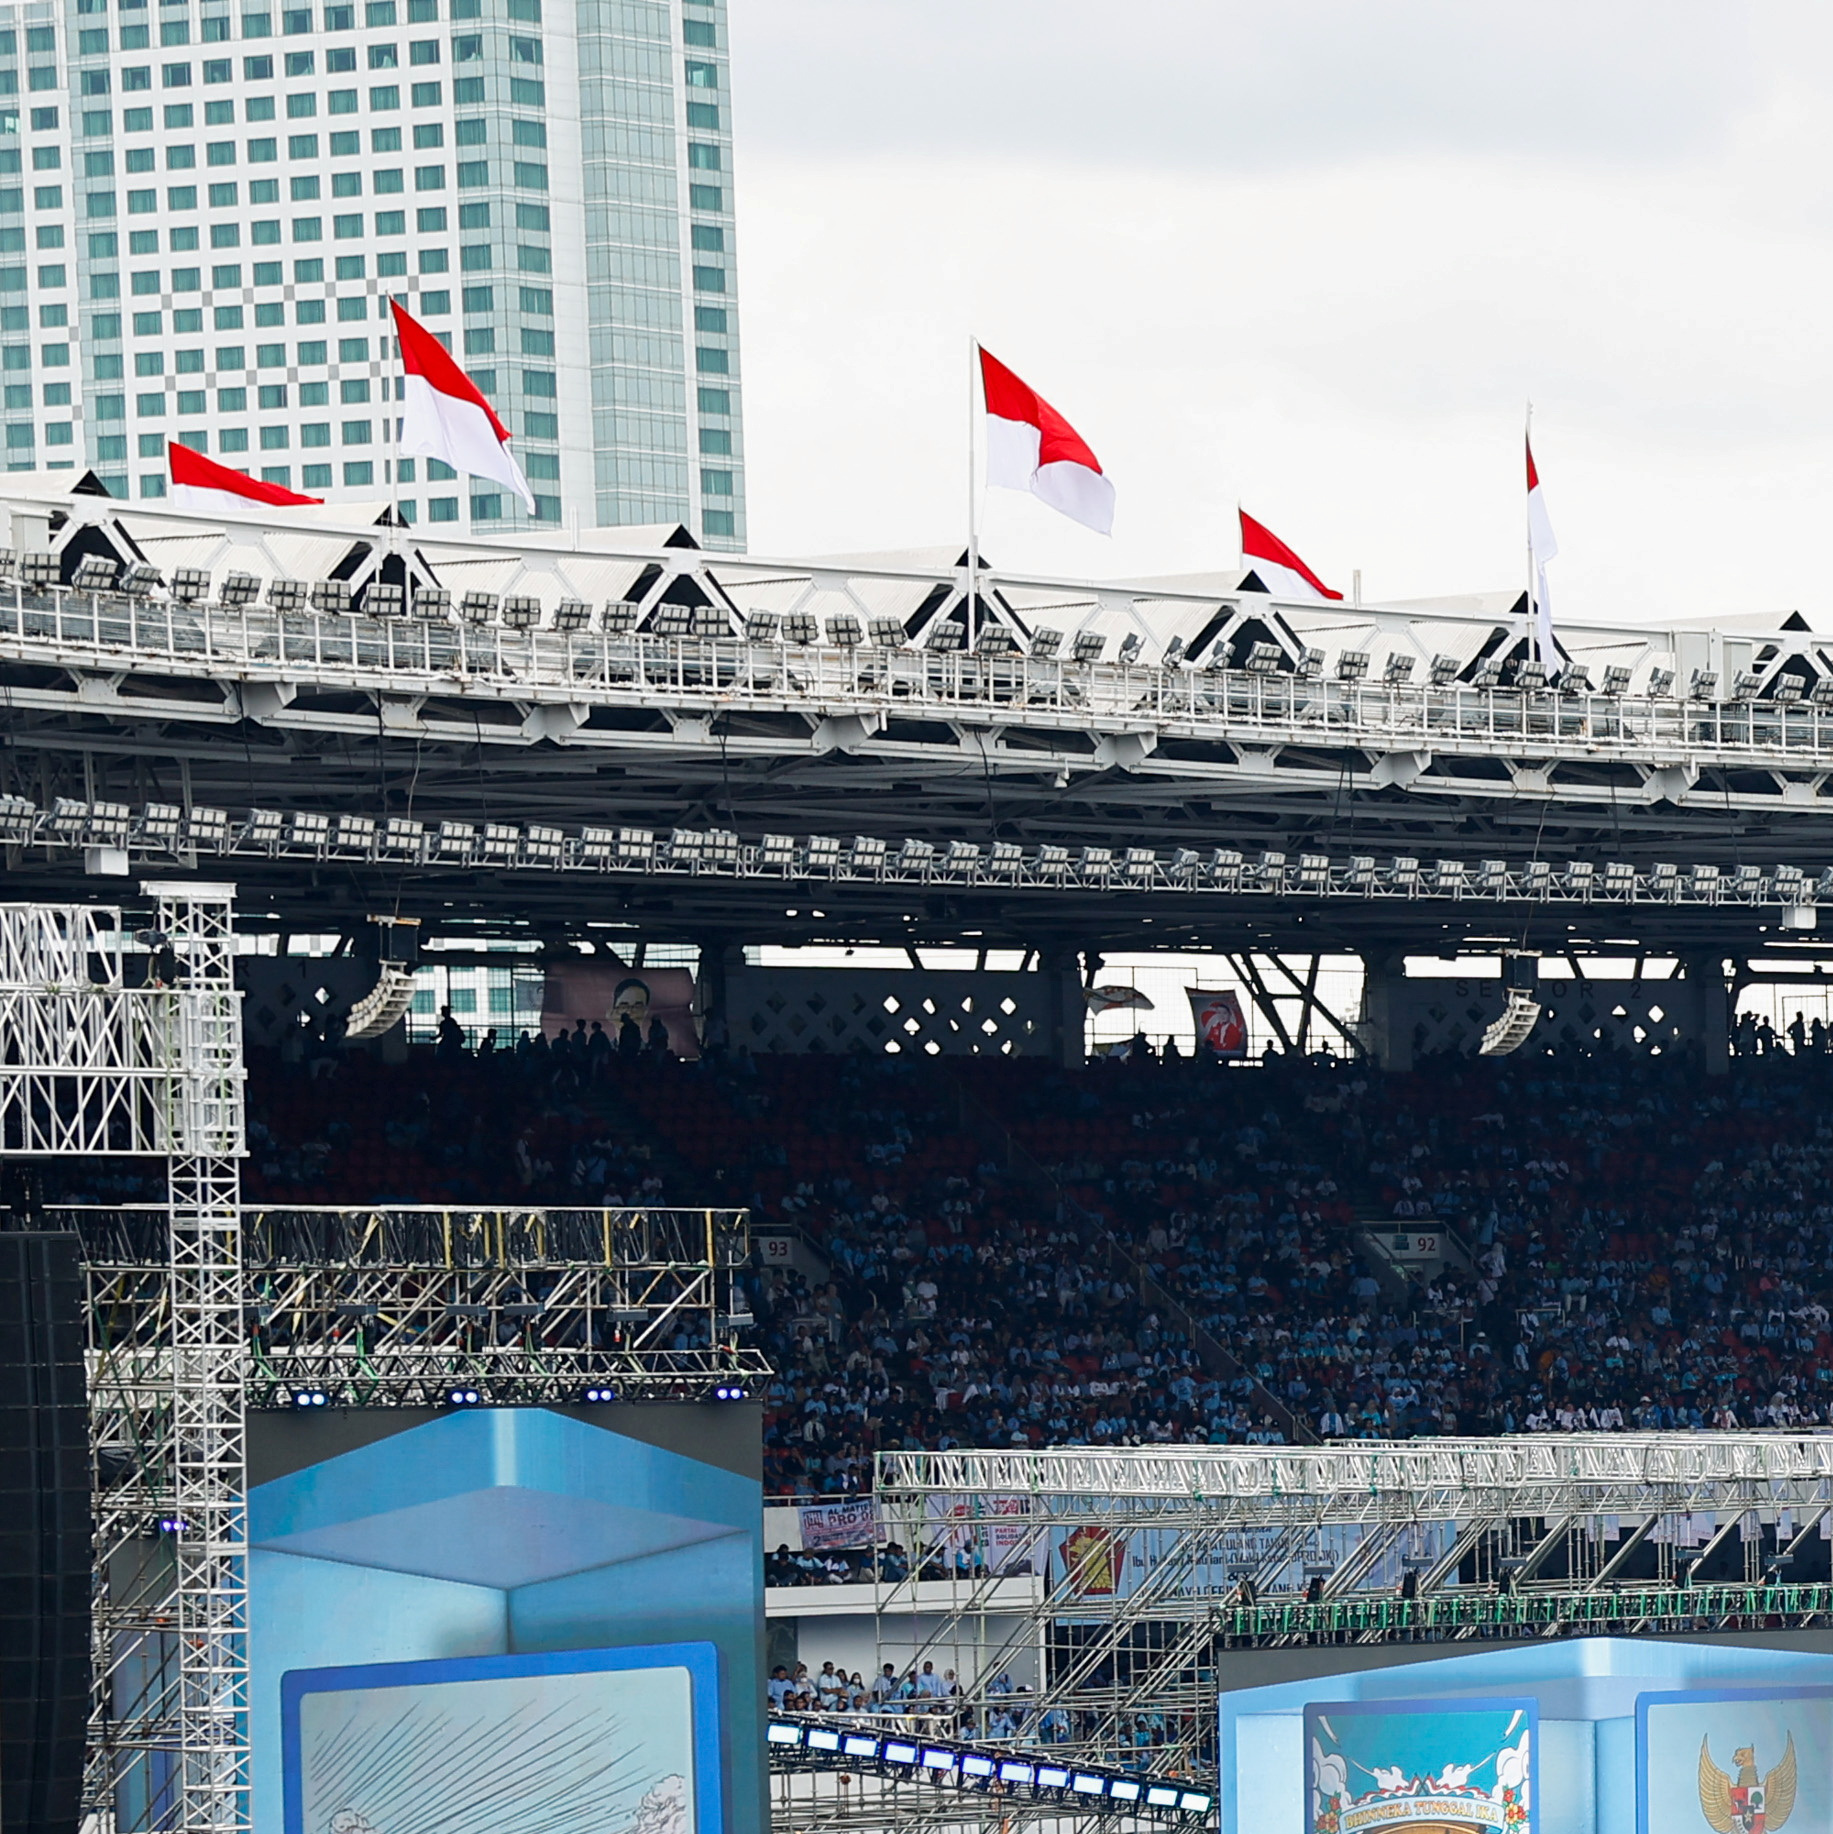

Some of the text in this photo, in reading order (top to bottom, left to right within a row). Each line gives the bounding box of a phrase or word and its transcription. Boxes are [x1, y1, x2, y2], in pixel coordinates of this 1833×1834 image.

[1455, 980, 1594, 999] SEOR
[769, 1241, 788, 1256] 93
[1418, 1238, 1436, 1252] 92
[828, 1513, 856, 1527] PRO
[1345, 1800, 1498, 1829] BHINNEKA TUNGGAL IKA
